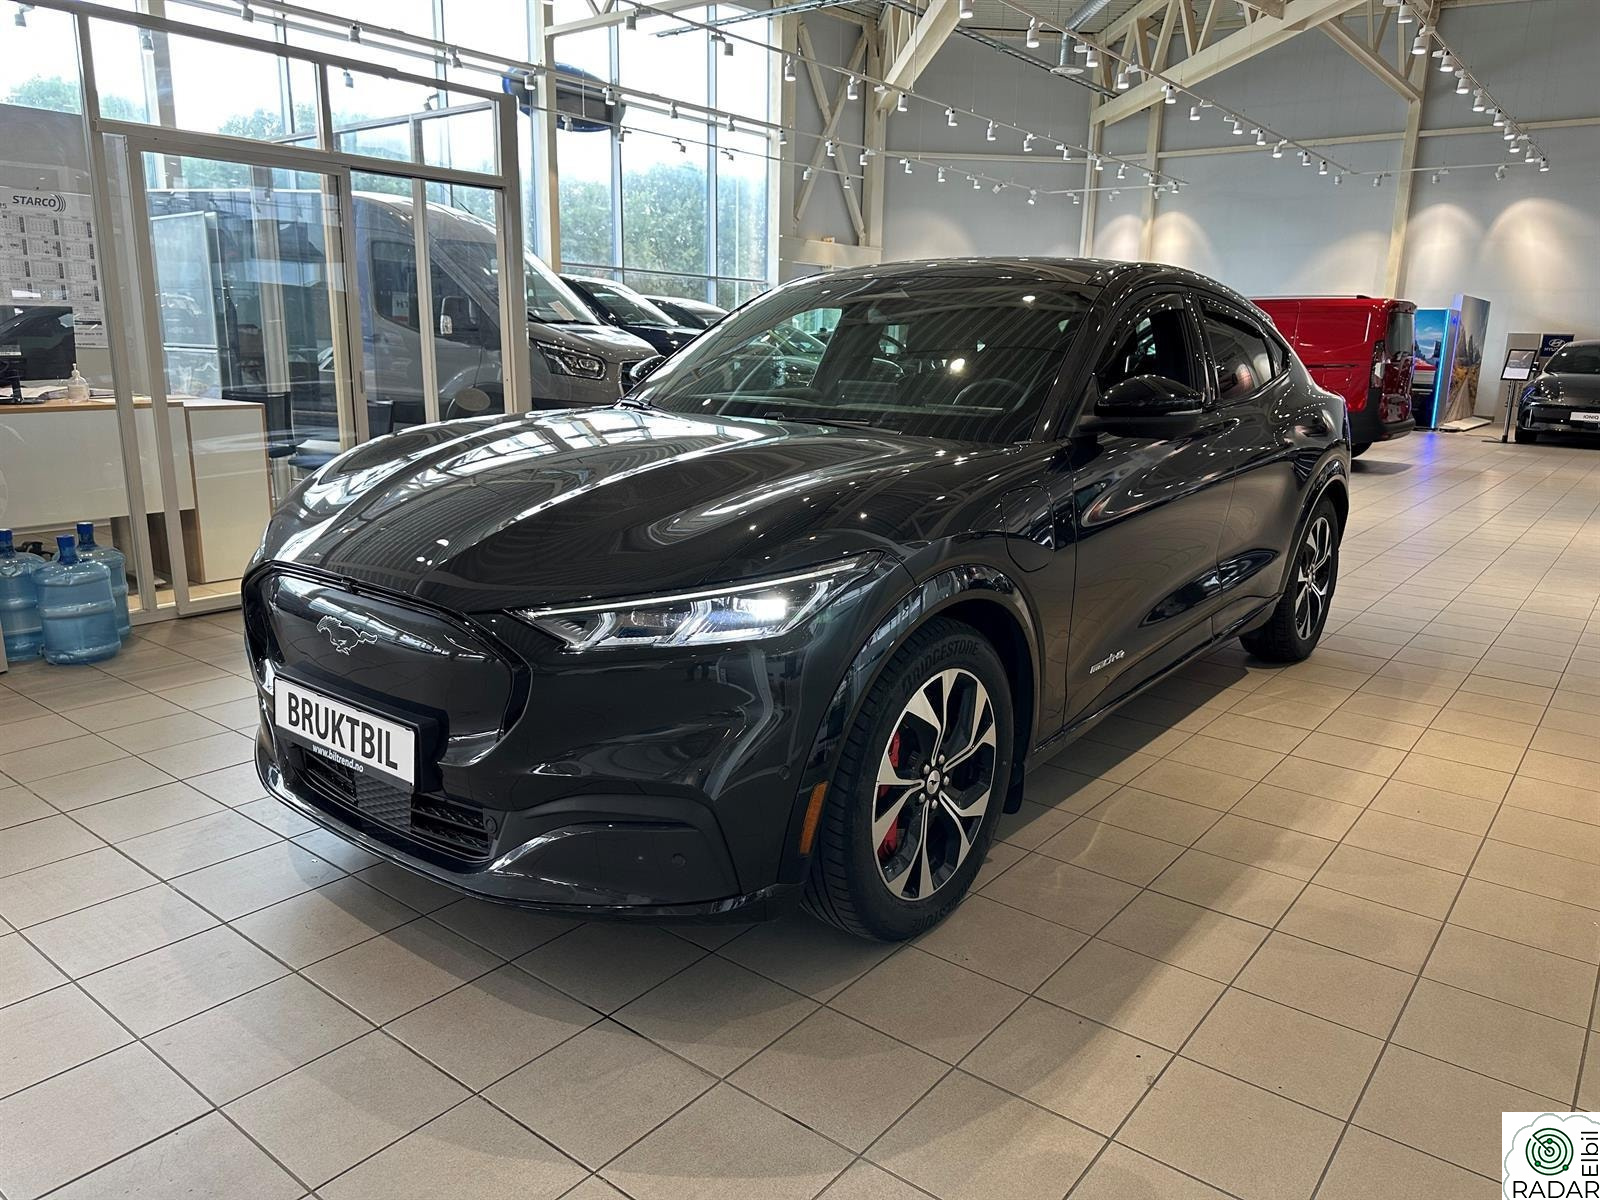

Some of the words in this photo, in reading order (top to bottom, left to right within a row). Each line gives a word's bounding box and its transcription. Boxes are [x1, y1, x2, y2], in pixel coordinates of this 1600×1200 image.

[12, 195, 57, 207] STARCO
[287, 691, 398, 770] BRUKTBIL
[312, 744, 364, 773] www.biltrend.no
